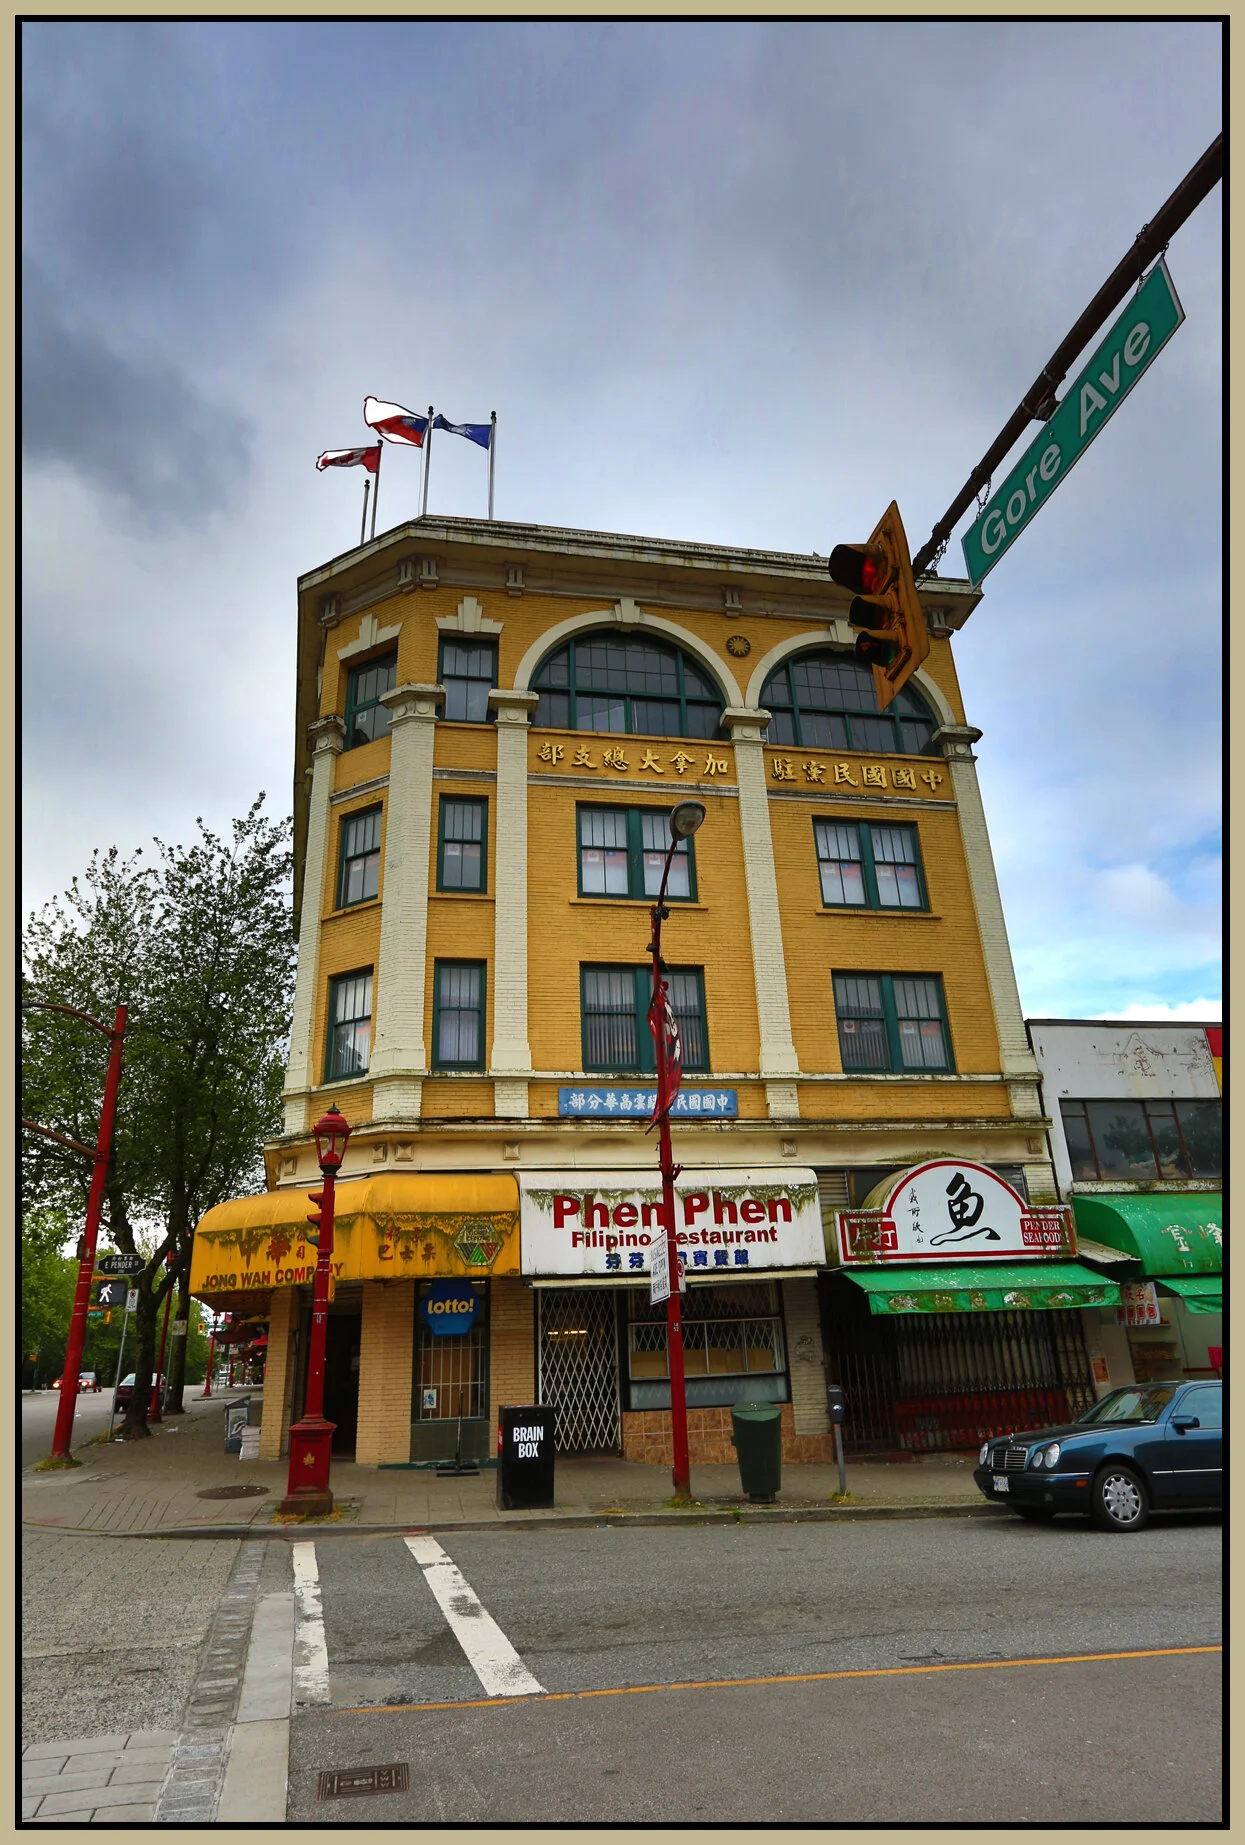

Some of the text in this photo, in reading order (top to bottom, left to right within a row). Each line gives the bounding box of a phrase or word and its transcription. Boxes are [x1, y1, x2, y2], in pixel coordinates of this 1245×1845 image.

[981, 322, 1151, 555] Gore Ave
[553, 1190, 793, 1229] Phen Phen
[930, 1172, 1001, 1246] 魚
[1024, 1220, 1060, 1231] PENDER
[571, 1230, 652, 1252] Filipino
[662, 1225, 779, 1246] estaurant
[1023, 1231, 1061, 1244] SEAFOOD
[110, 1261, 133, 1269] PENDER
[202, 1262, 344, 1290] JONG WAH COMPY
[427, 1299, 475, 1315] lotto!
[512, 1426, 544, 1443] BRAIN
[518, 1442, 539, 1459] BOX
